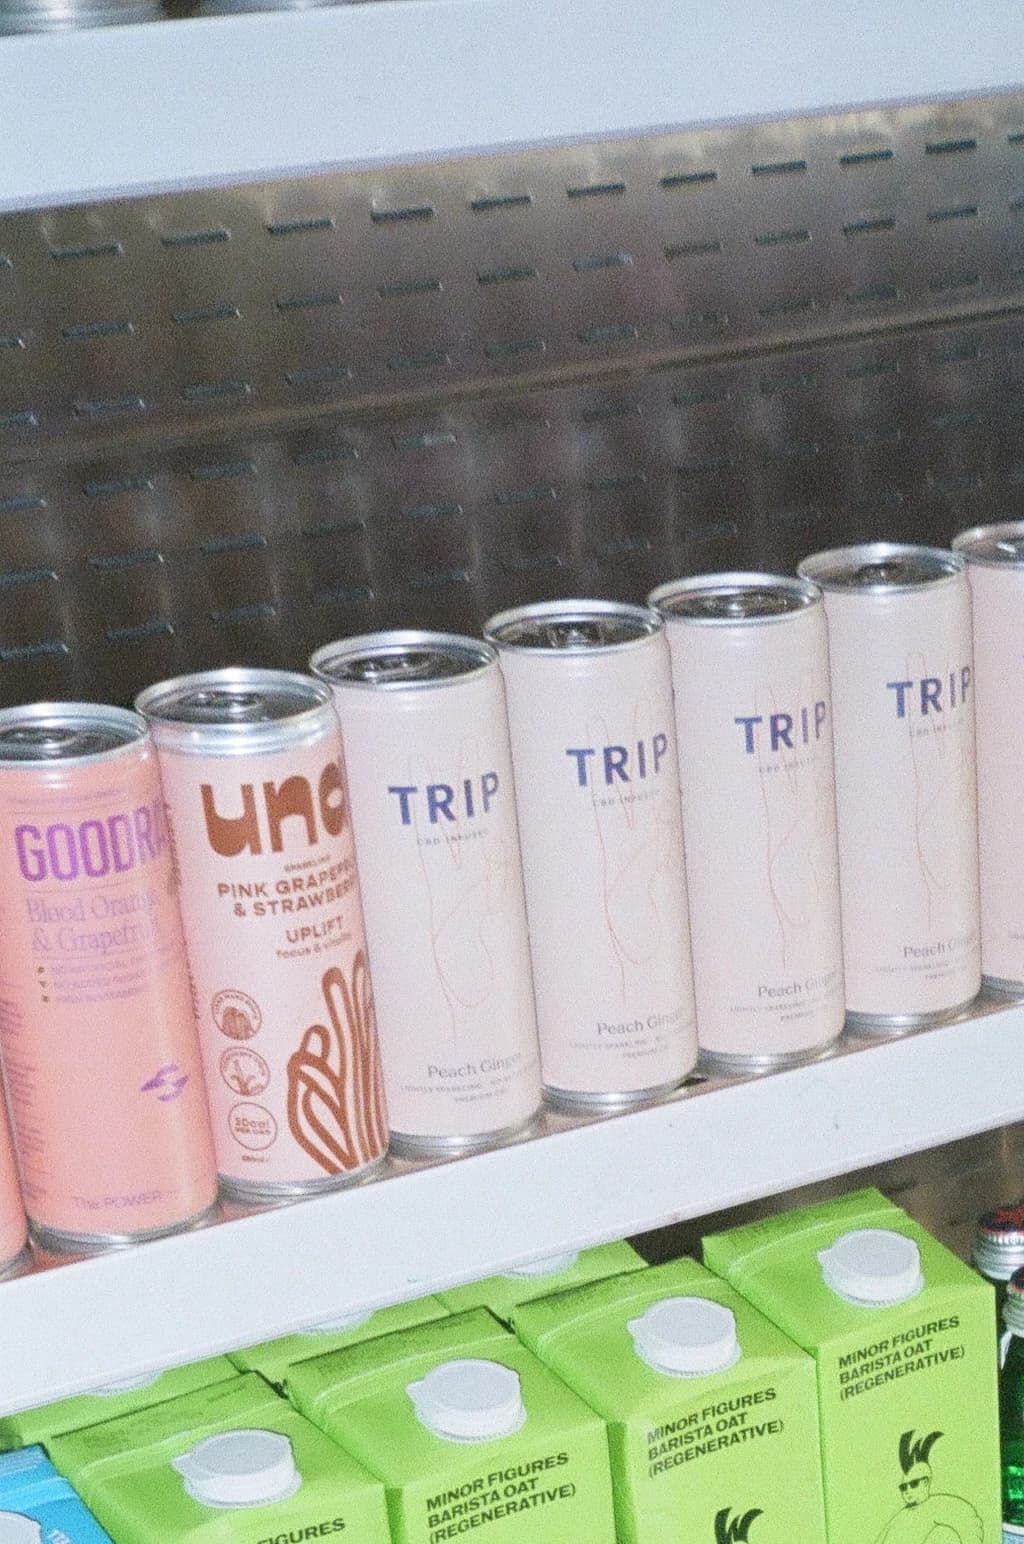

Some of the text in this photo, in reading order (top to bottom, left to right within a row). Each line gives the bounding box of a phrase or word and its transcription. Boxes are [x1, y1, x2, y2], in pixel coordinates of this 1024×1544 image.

[885, 665, 972, 719] TRIP
[734, 701, 827, 755] TRIP
[565, 732, 669, 788] TRIP
[387, 771, 500, 826] TRIP
[217, 881, 269, 899] PINK
[233, 902, 247, 917] &
[285, 914, 344, 944] UPLIFT
[757, 981, 802, 999] Peach
[596, 1019, 644, 1035] Peach
[427, 1062, 478, 1079] Peach
[838, 1315, 960, 1370] MINOR FIGURES
[838, 1338, 935, 1386] BARISTA OAT
[839, 1344, 966, 1402] (REGENERATIVE)
[647, 1387, 778, 1445] MINOR FIGURES
[648, 1412, 749, 1462] BARISTA OAT
[648, 1418, 785, 1480] (REGENERATIVE)
[425, 1451, 570, 1513] MINOR FIGURES
[427, 1477, 540, 1529] BARISTA OAT
